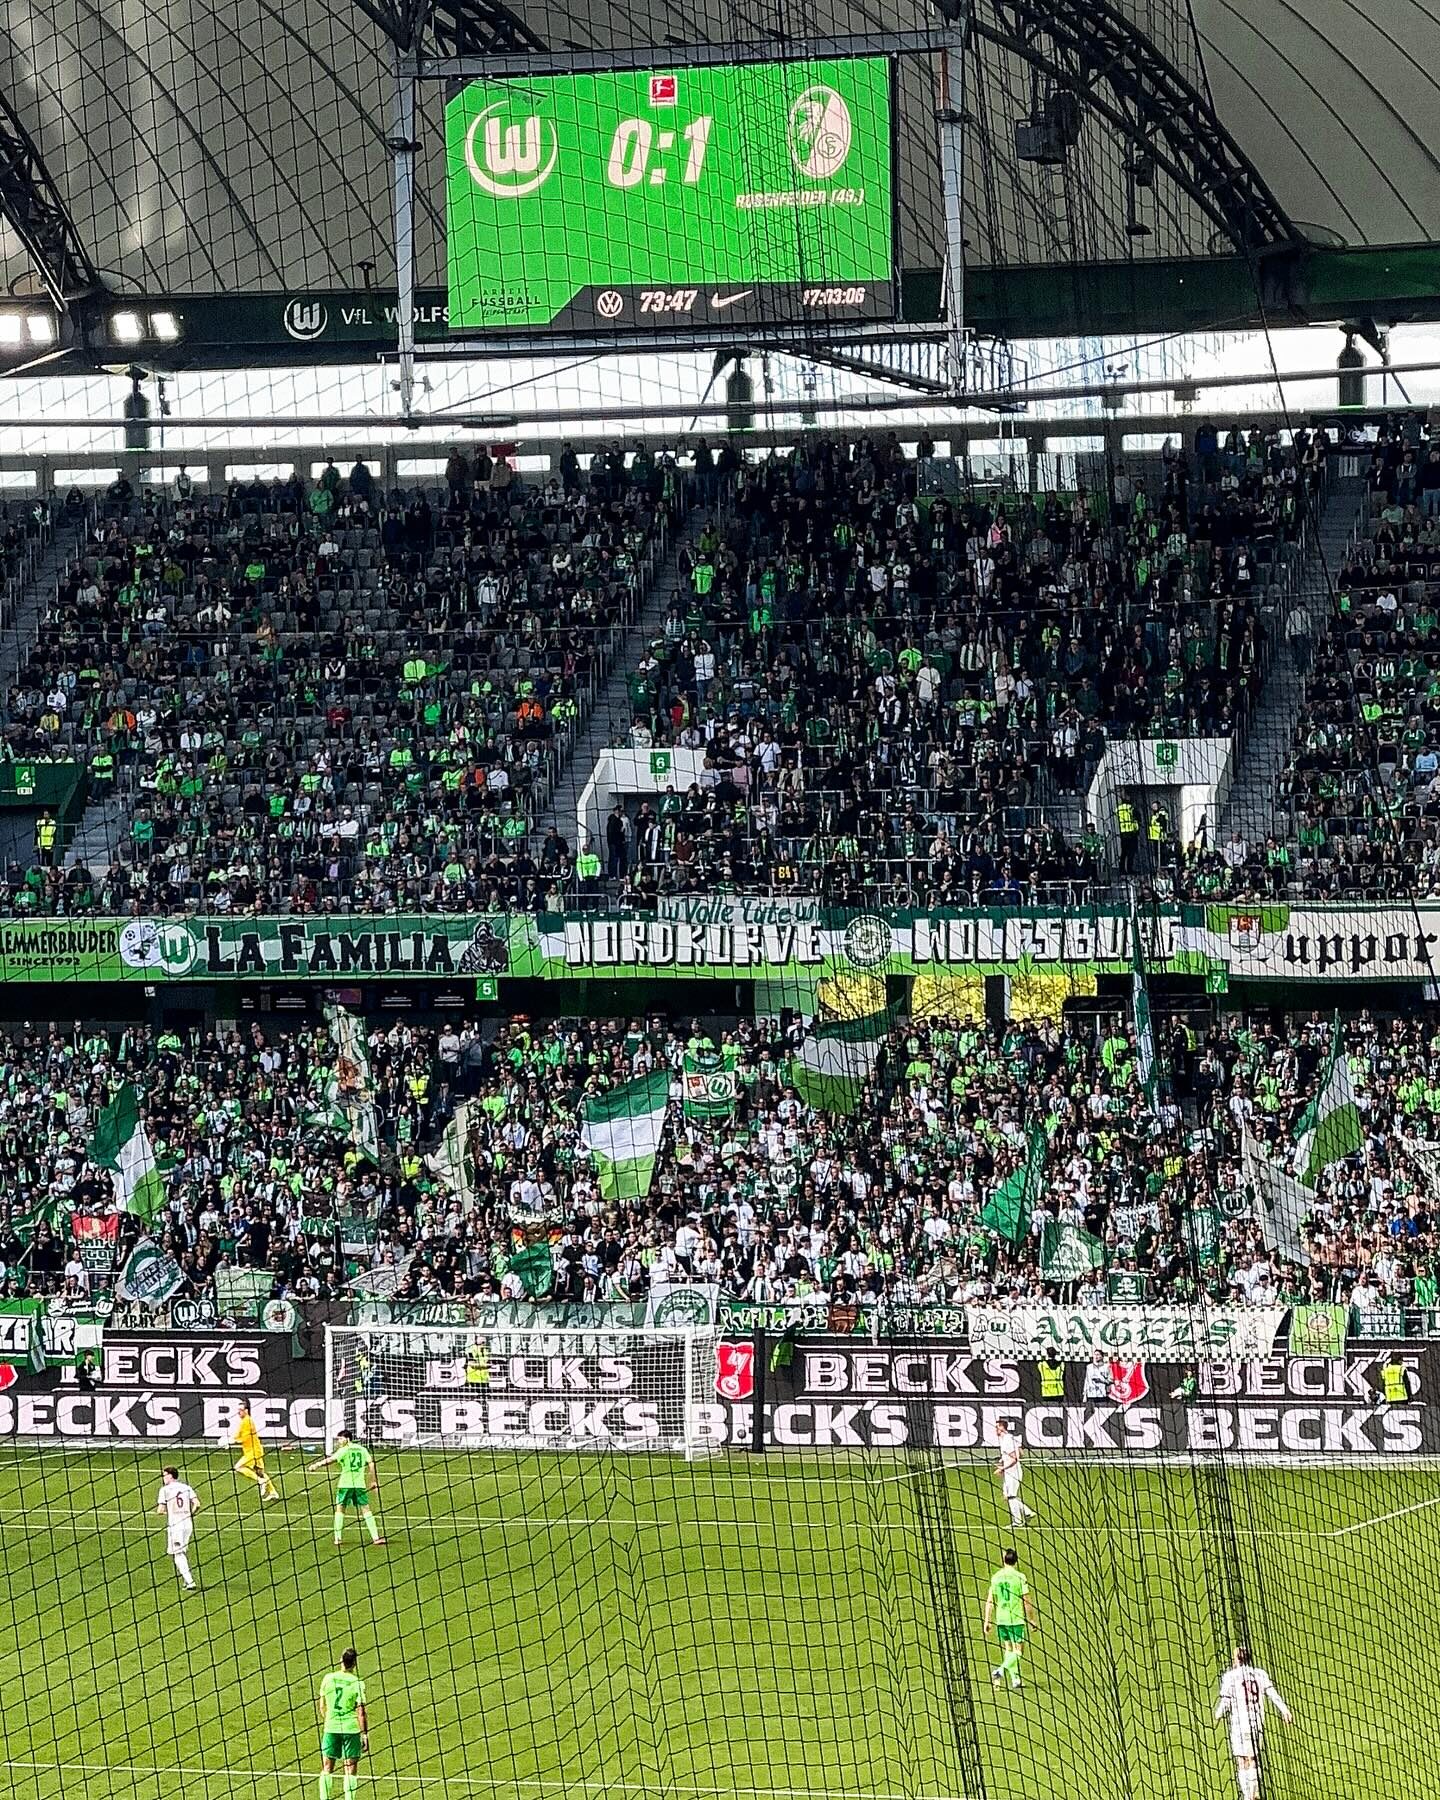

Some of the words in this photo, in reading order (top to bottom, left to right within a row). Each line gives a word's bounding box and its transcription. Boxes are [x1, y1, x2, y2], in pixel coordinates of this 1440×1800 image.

[608, 116, 712, 187] 0:1
[471, 296, 541, 307] FUSSBALL
[640, 289, 698, 313] 73:47
[340, 308, 372, 325] VfL
[656, 757, 666, 769] 6
[778, 865, 791, 879] 84
[682, 897, 734, 925] Volle
[0, 919, 117, 955] EMMERBRÜDER
[204, 924, 267, 973] LA
[277, 922, 456, 973] FAMILIA
[564, 920, 825, 966] NORDKURVE
[911, 915, 1182, 965] WOLFSBURG
[1239, 930, 1439, 974] uppor
[482, 981, 493, 996] 5
[1212, 976, 1222, 988] 7
[1031, 1315, 1238, 1348] ANGELS
[440, 1396, 660, 1437] BECK'S
[1186, 1405, 1424, 1451] BECK'S
[350, 1452, 363, 1468] 23
[176, 1490, 184, 1509] 6
[333, 1686, 344, 1711] 2
[1241, 1679, 1260, 1705] 19
